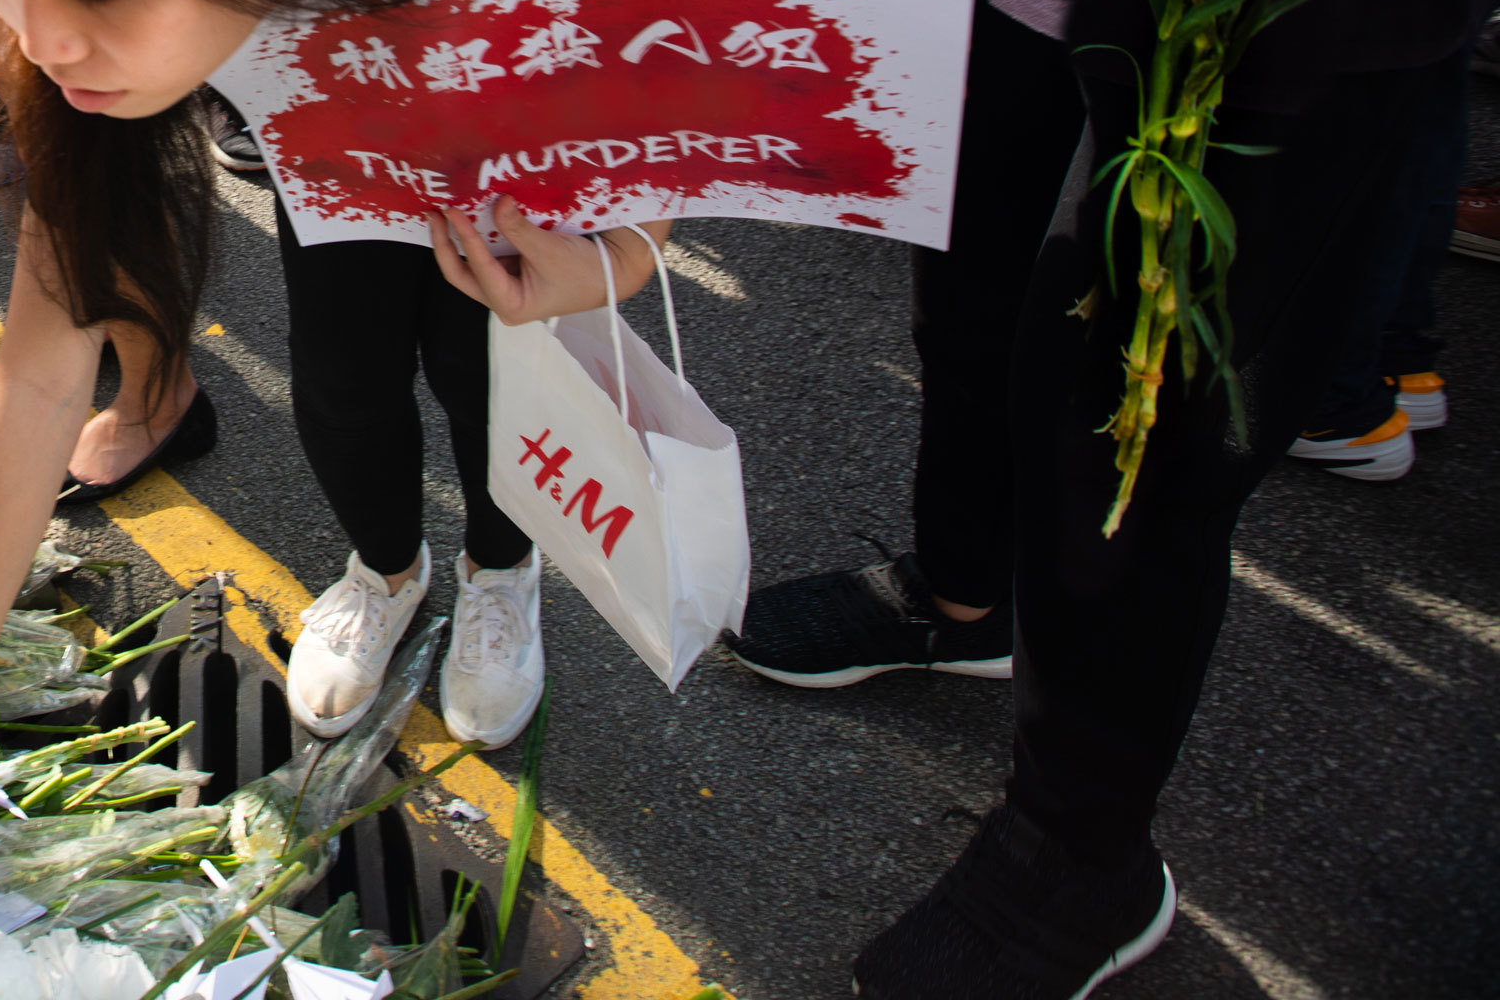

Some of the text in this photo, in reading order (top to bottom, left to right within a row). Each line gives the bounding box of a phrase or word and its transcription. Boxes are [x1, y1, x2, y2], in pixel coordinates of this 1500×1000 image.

[344, 130, 803, 200] THE MURDERER
[518, 428, 635, 560] H&M
